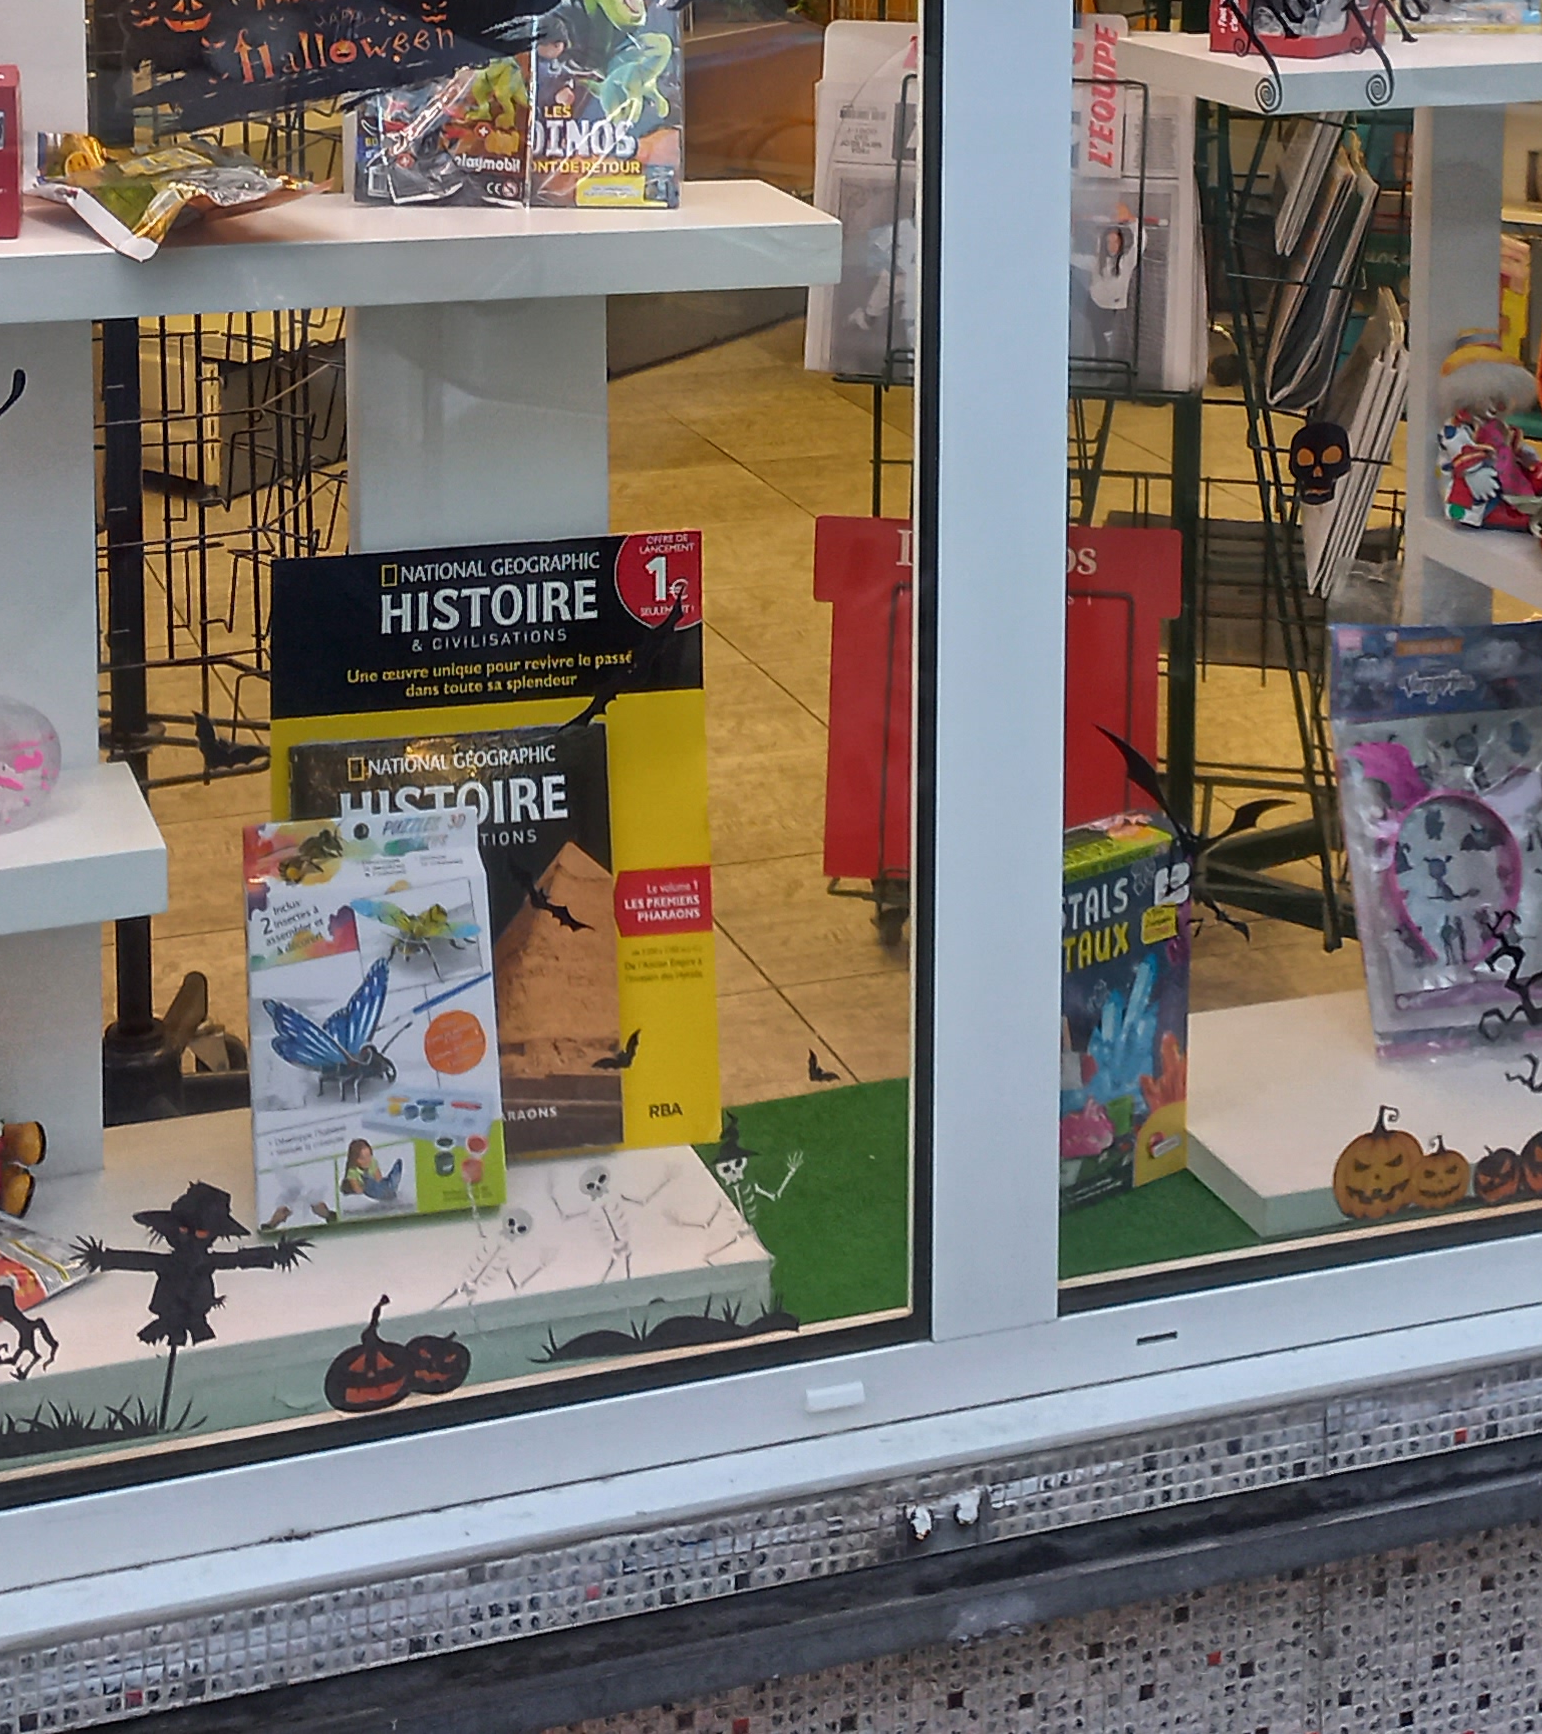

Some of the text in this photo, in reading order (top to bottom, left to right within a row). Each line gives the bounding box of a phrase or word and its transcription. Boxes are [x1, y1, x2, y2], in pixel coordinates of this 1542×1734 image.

[544, 104, 571, 118] LES
[582, 160, 642, 175] RETOUR
[638, 542, 695, 555] LANCEMENT
[400, 551, 601, 584] NATIONAL GEOGRAPHIC
[380, 577, 600, 636] HISTOIRE
[411, 627, 568, 654] & CIVILISATIONS
[346, 667, 378, 684] Une
[432, 662, 482, 682] unique
[485, 658, 519, 680] pour
[523, 654, 575, 672] revivre
[577, 652, 592, 668] le
[594, 649, 633, 672] passé
[405, 672, 578, 699] dans toute sa splendeur
[367, 750, 447, 777] NATIONAL
[339, 774, 569, 825] HISTOIRE
[624, 893, 700, 911] LES PREMIERS
[636, 907, 701, 923] PHARAONS
[259, 917, 273, 936] 2
[1062, 920, 1131, 974] TAUX
[648, 1101, 684, 1120] RBA
